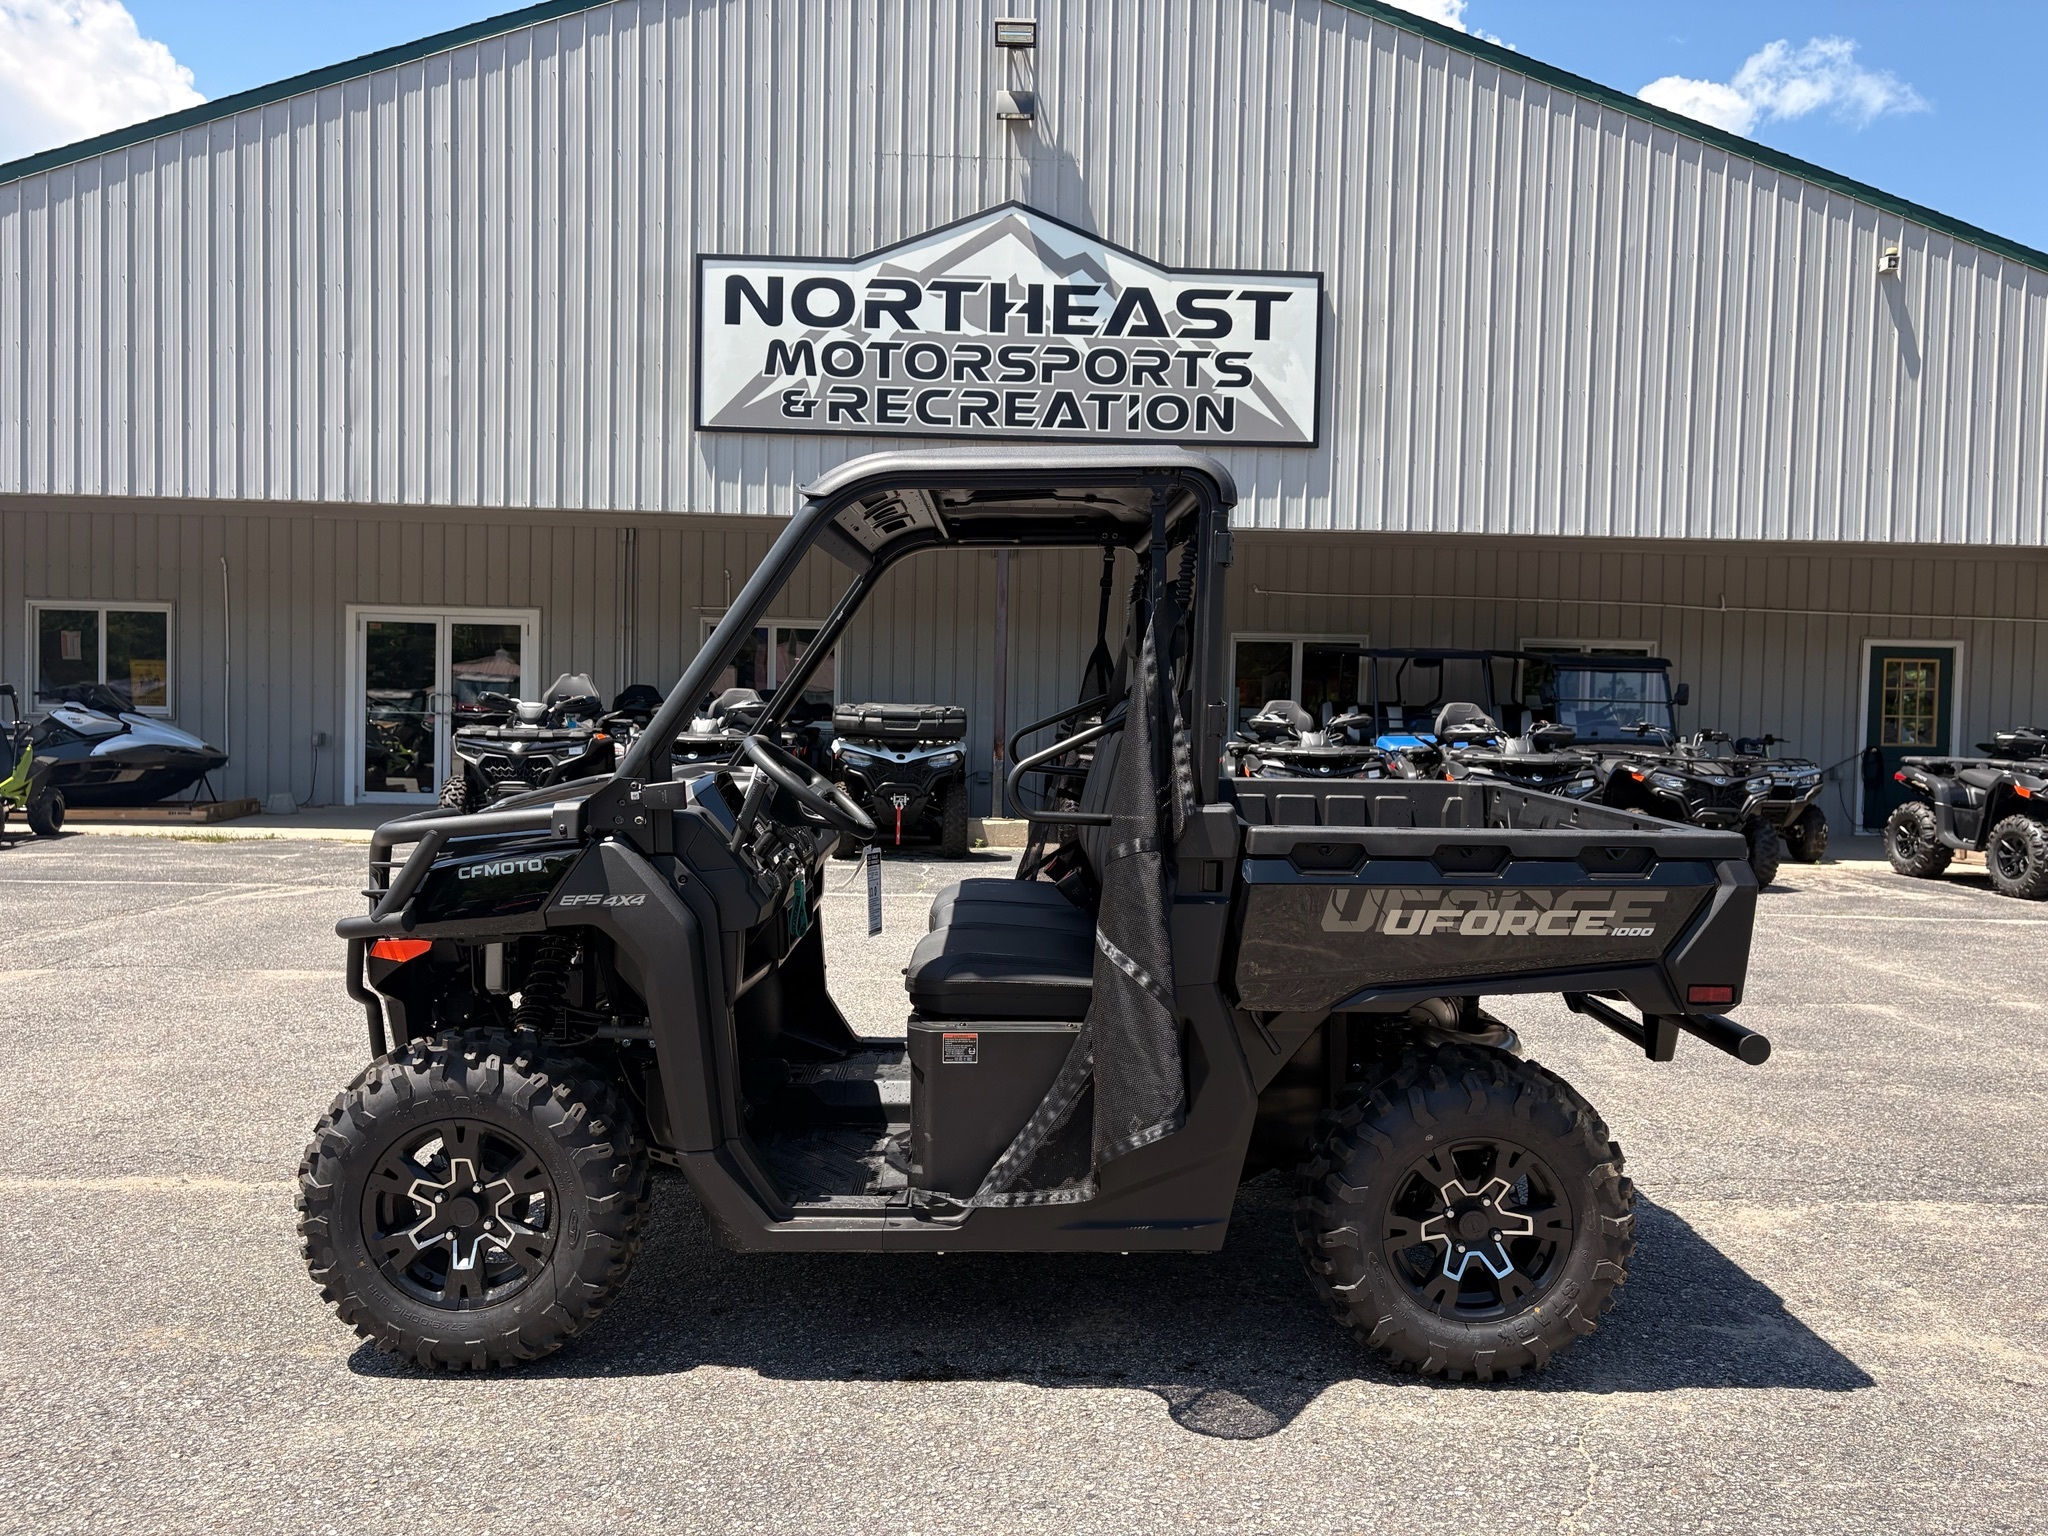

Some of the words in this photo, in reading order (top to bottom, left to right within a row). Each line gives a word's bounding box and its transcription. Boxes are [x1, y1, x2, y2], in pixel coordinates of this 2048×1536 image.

[723, 274, 1294, 342] NORTHEAST
[763, 338, 1254, 389] MOTORSPORTS
[458, 858, 543, 880] CFMOTO
[559, 894, 603, 907] EPS
[1383, 908, 1617, 937] UFORCE
[1610, 926, 1655, 938] 1000
